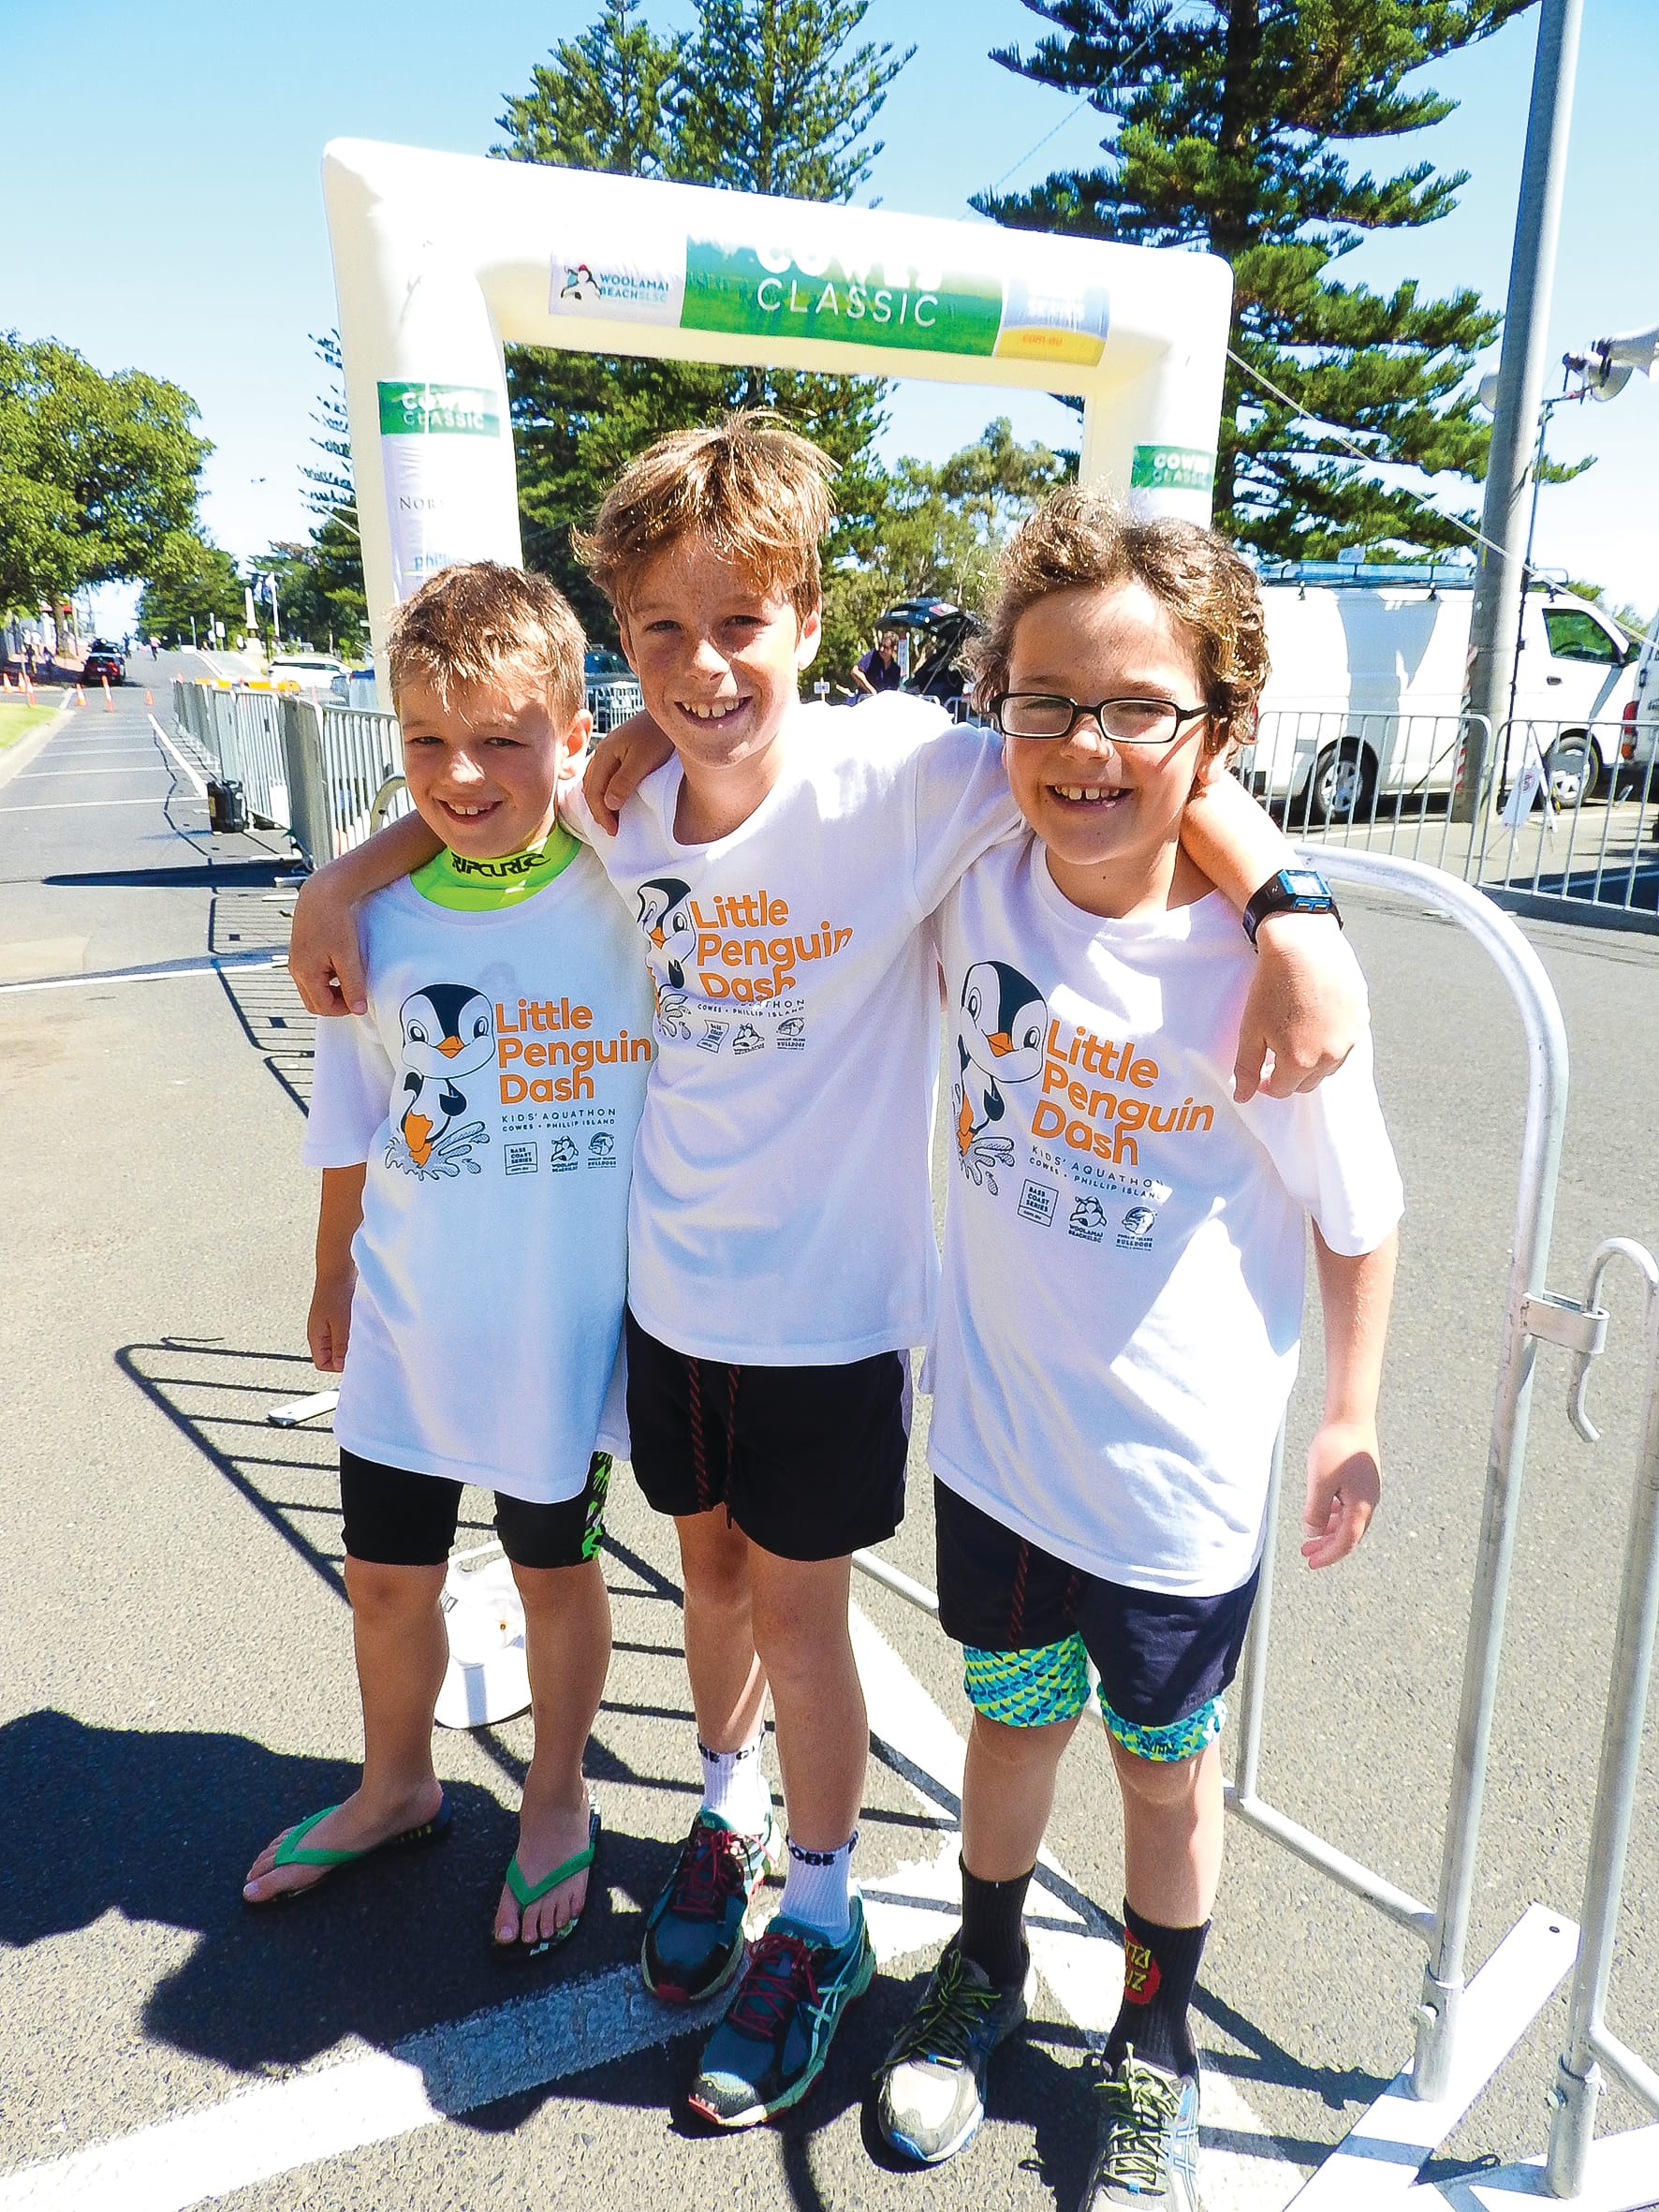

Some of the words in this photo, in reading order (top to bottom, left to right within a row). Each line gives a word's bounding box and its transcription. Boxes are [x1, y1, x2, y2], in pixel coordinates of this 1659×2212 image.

[600, 273, 668, 292] WOOLAMAI
[756, 276, 939, 328] CLASSIC
[403, 410, 484, 430] CLASSIC
[690, 890, 789, 930] Little
[697, 921, 854, 971] Penguin
[698, 966, 796, 1003] Dash
[495, 997, 593, 1034] Little
[697, 1003, 722, 1013] COWES
[733, 1008, 763, 1017] PHILLIP
[768, 1006, 804, 1018] ISLAND
[497, 1030, 652, 1072] Penguin
[1047, 1019, 1159, 1089] Little
[499, 1066, 595, 1105] Dash
[1041, 1061, 1215, 1134] Penguin
[502, 1124, 534, 1132] COWES
[546, 1120, 579, 1128] PHILLIP
[542, 1108, 617, 1121] AQUATHON
[1031, 1099, 1139, 1166] Dash
[1029, 1157, 1060, 1175] COWES
[1074, 1175, 1118, 1191] PHILLIP
[1026, 1200, 1049, 1213] SERIES
[1027, 1193, 1050, 1206] COAST
[1069, 1224, 1104, 1238] WOOLAMAI
